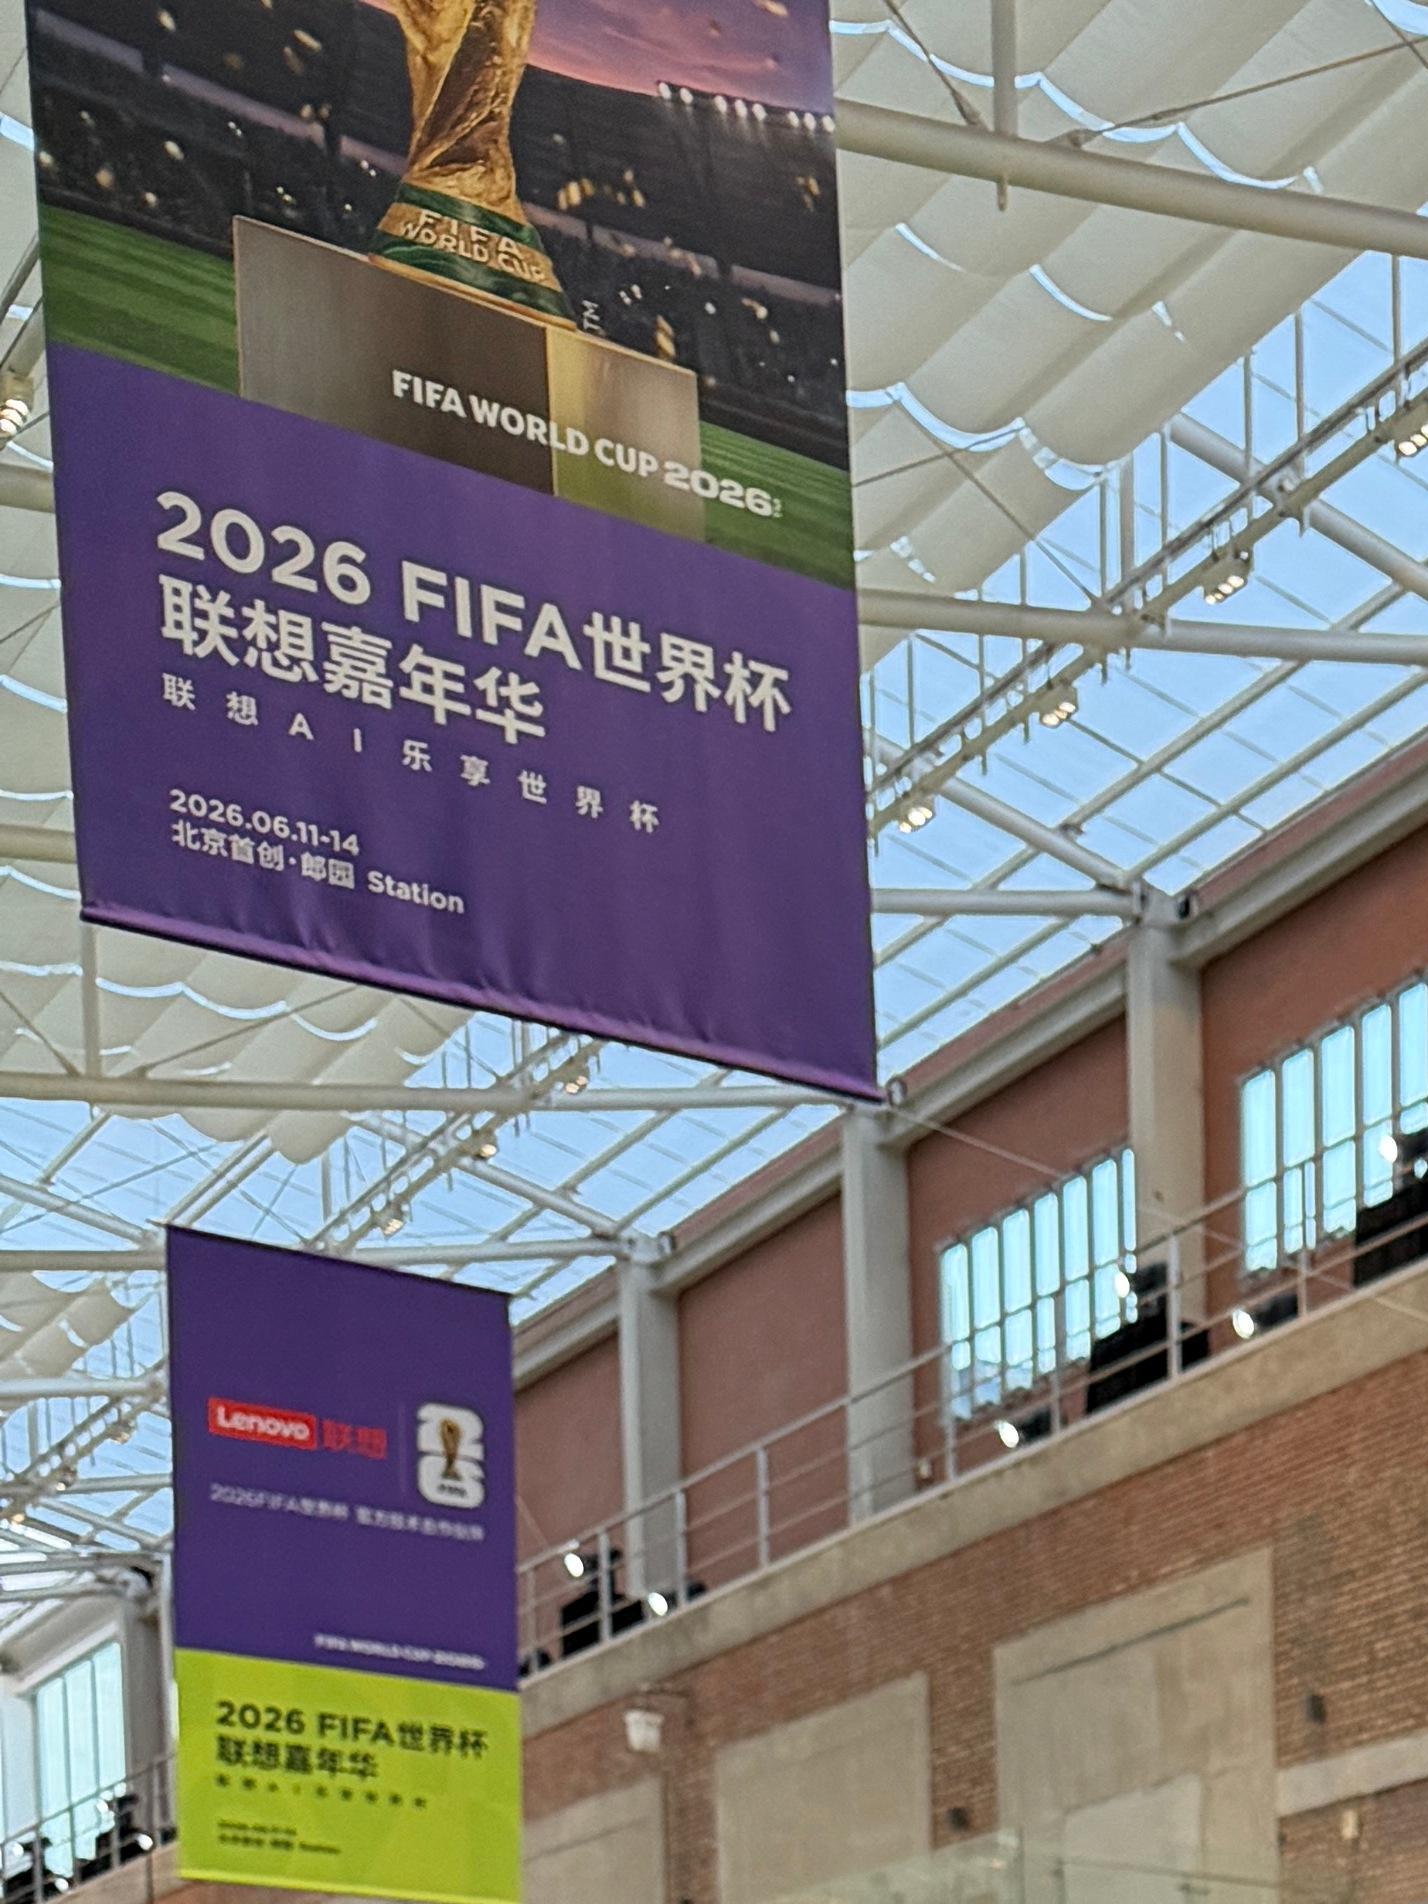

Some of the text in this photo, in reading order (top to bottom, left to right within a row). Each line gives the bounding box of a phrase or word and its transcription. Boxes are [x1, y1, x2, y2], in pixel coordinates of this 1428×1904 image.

[400, 221, 547, 281] WORLD CUP
[418, 209, 524, 259] FIFA
[392, 368, 774, 518] FIFA WORLD CUP 2026
[156, 491, 794, 733] 2026 FIFA世界杯
[157, 573, 547, 745] 联想嘉年华
[169, 788, 360, 857] 2026.06.11-14
[367, 869, 465, 915] Station
[215, 1405, 311, 1441] Lenovo
[215, 1733, 379, 1780] 联想嘉年华
[216, 1700, 489, 1760] 2026 FIFA世界杯
